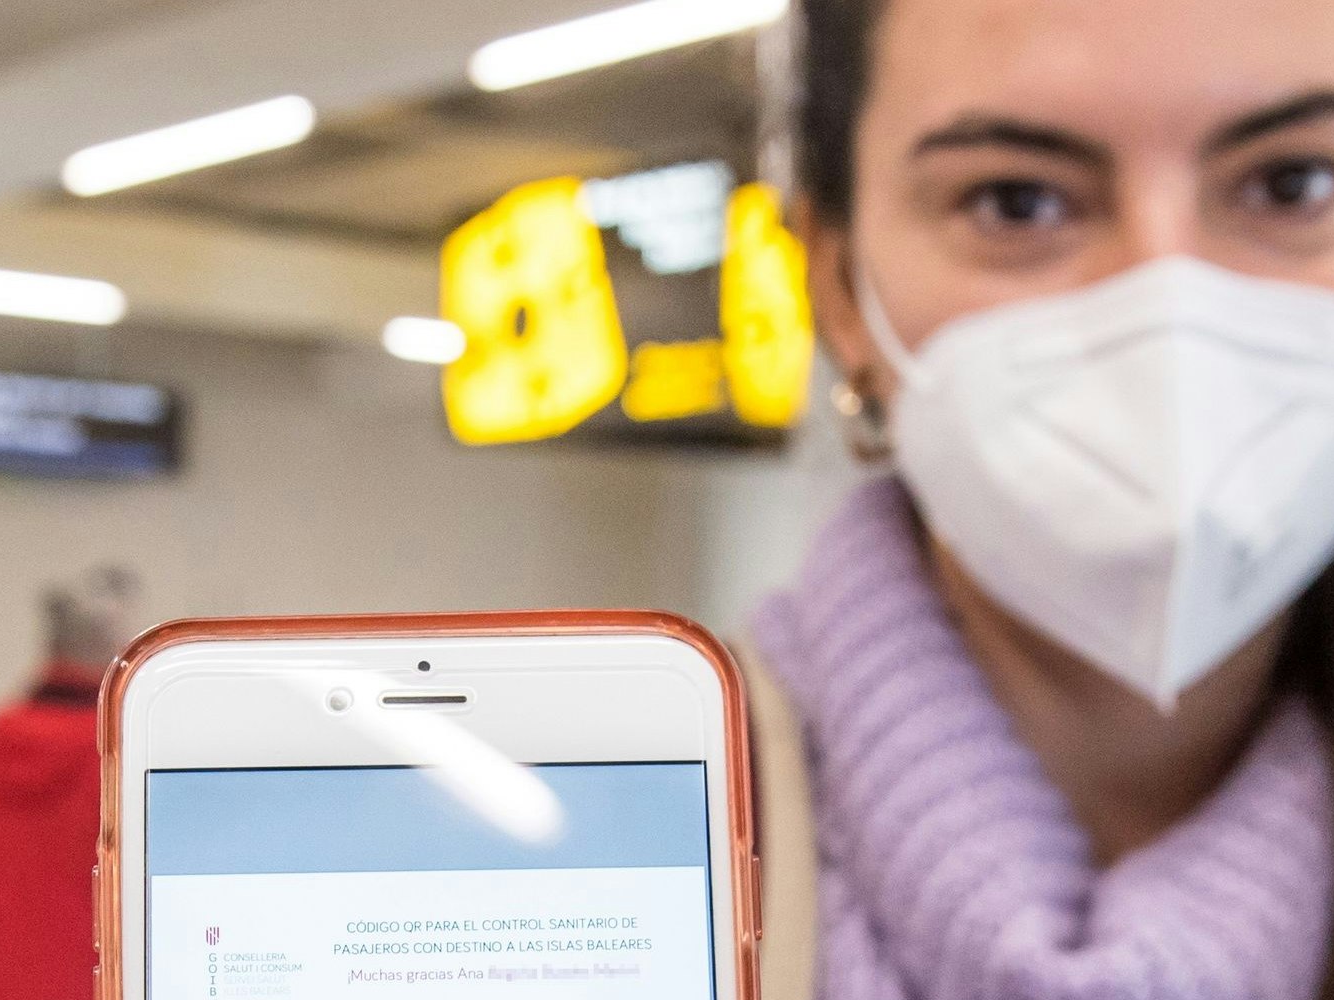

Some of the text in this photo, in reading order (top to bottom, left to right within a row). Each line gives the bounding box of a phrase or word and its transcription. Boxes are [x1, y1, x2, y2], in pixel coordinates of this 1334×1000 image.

[346, 918, 637, 934] CÓDIGO QR PARA EL CONTROL SANITARIO DE
[333, 943, 409, 955] PASAJEROS
[413, 942, 442, 954] CON
[446, 941, 502, 953] DESTINO
[519, 940, 543, 952] LAS
[547, 940, 583, 952] ISLAS
[587, 939, 652, 951] BALEARES
[223, 952, 287, 961] CONSELLERIA
[223, 964, 253, 973] SALUT
[261, 963, 303, 972] CONSUM
[407, 968, 453, 983] gracias
[457, 966, 484, 979] Ana
